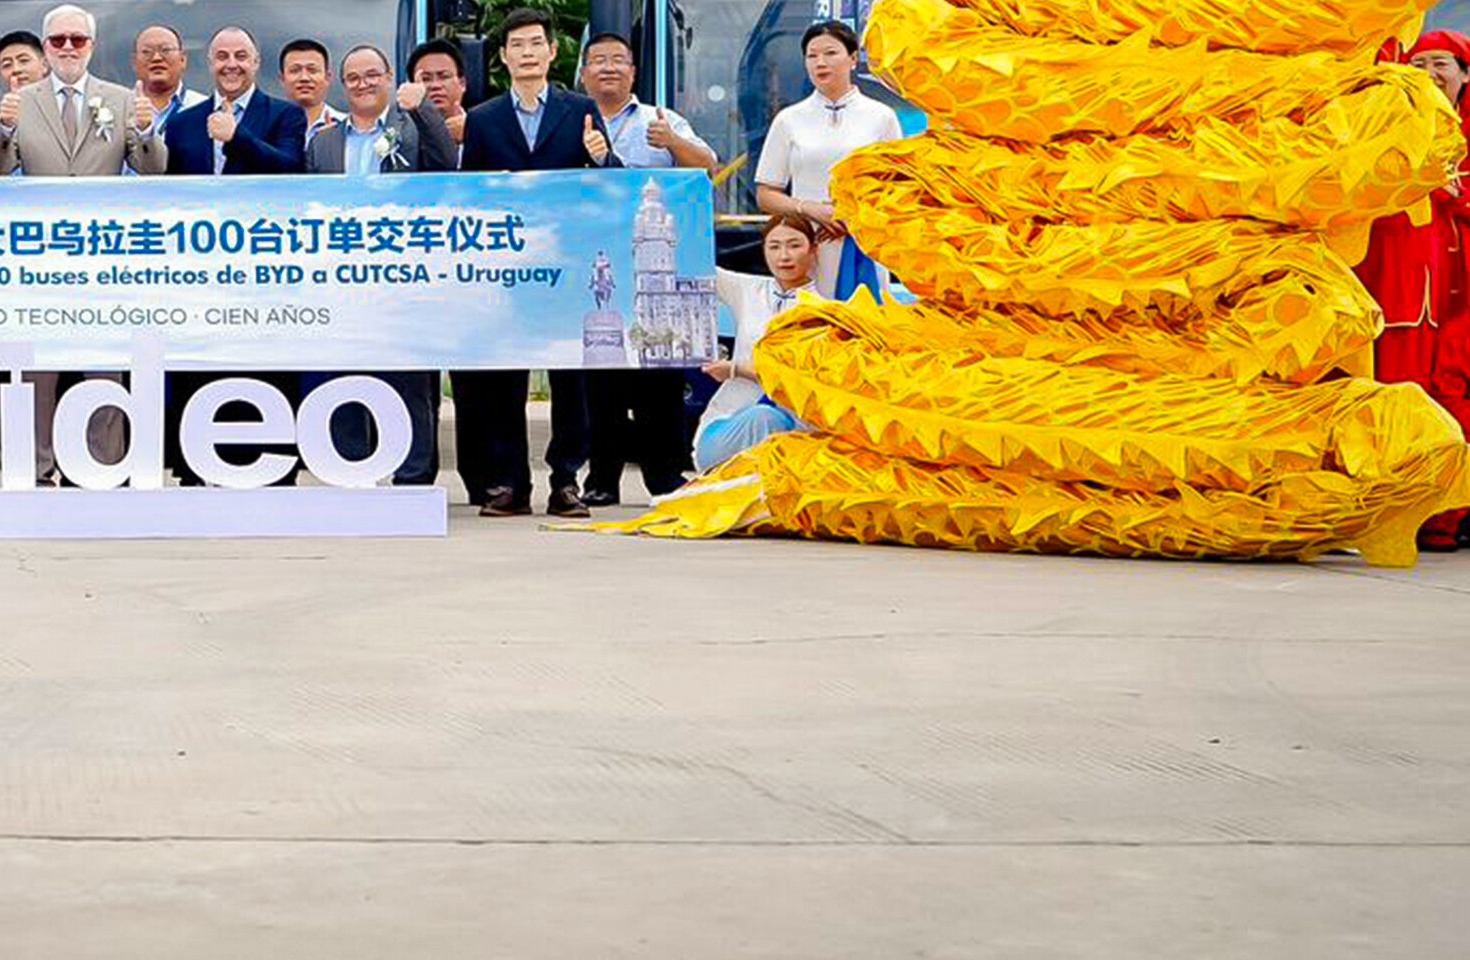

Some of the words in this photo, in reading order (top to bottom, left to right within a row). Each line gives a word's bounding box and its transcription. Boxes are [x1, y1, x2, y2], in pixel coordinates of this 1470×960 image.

[19, 265, 89, 286] buses
[96, 263, 209, 286] eléctricos
[216, 264, 247, 286] de
[254, 265, 305, 284] BYD
[312, 270, 328, 284] a
[334, 264, 430, 284] CUTCSA
[456, 264, 562, 288] Uruguay
[14, 303, 188, 326] TECNOLÓGICO
[205, 308, 259, 326] CIEN
[266, 303, 331, 326] AÑOS
